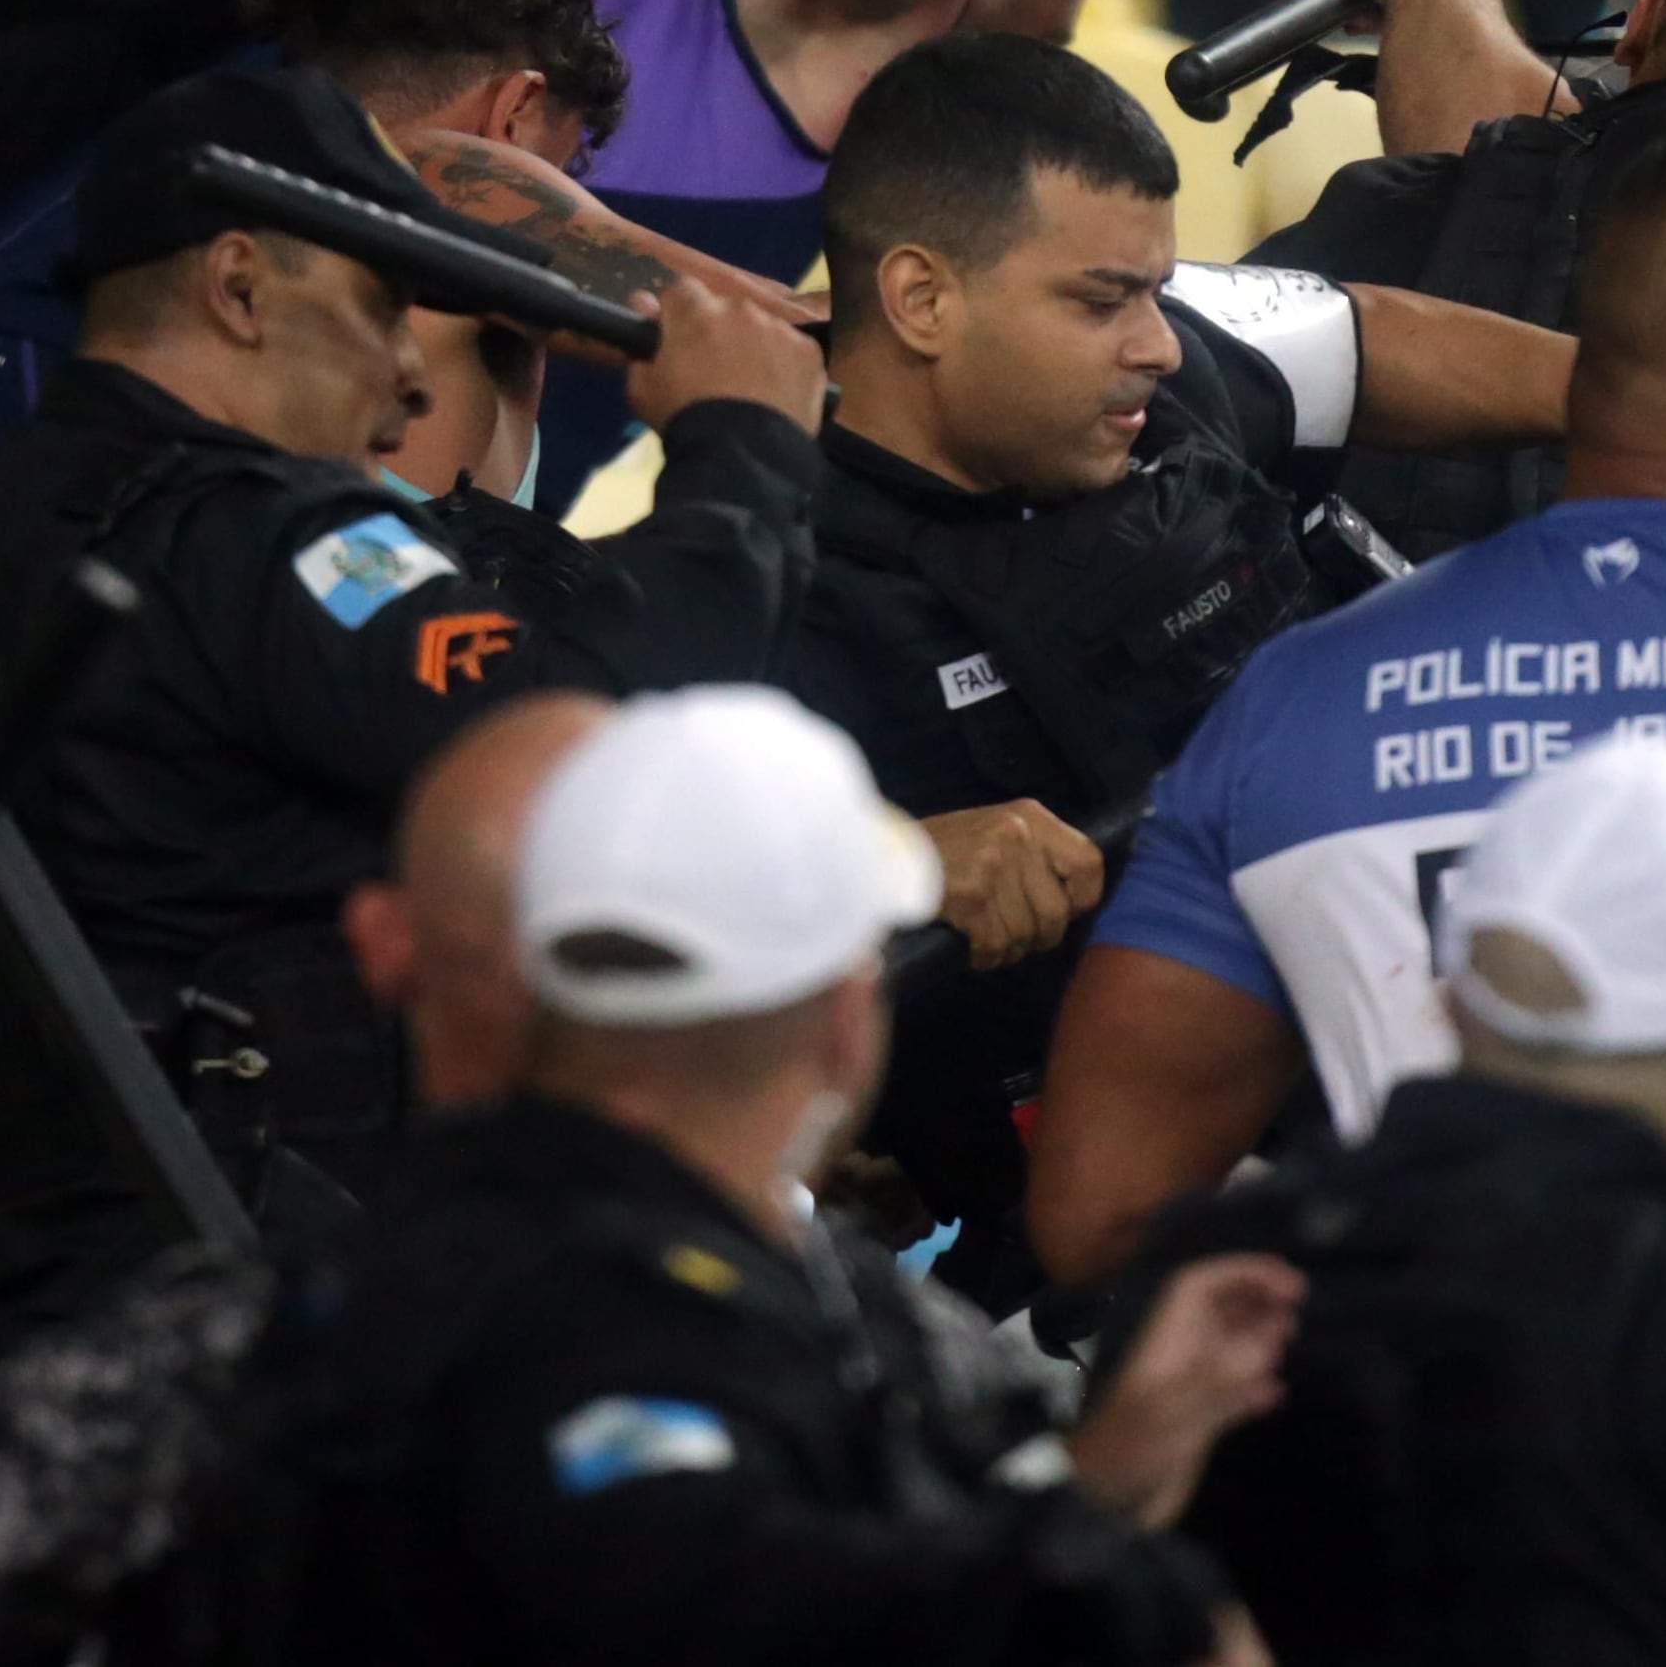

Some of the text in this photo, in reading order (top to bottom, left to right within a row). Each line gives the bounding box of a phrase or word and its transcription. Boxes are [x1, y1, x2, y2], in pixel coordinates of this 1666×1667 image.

[1161, 579, 1231, 640] FAUSTO
[1364, 636, 1602, 713] POLÍCIA
[1374, 724, 1473, 792] RIO
[1489, 720, 1573, 778] DE
